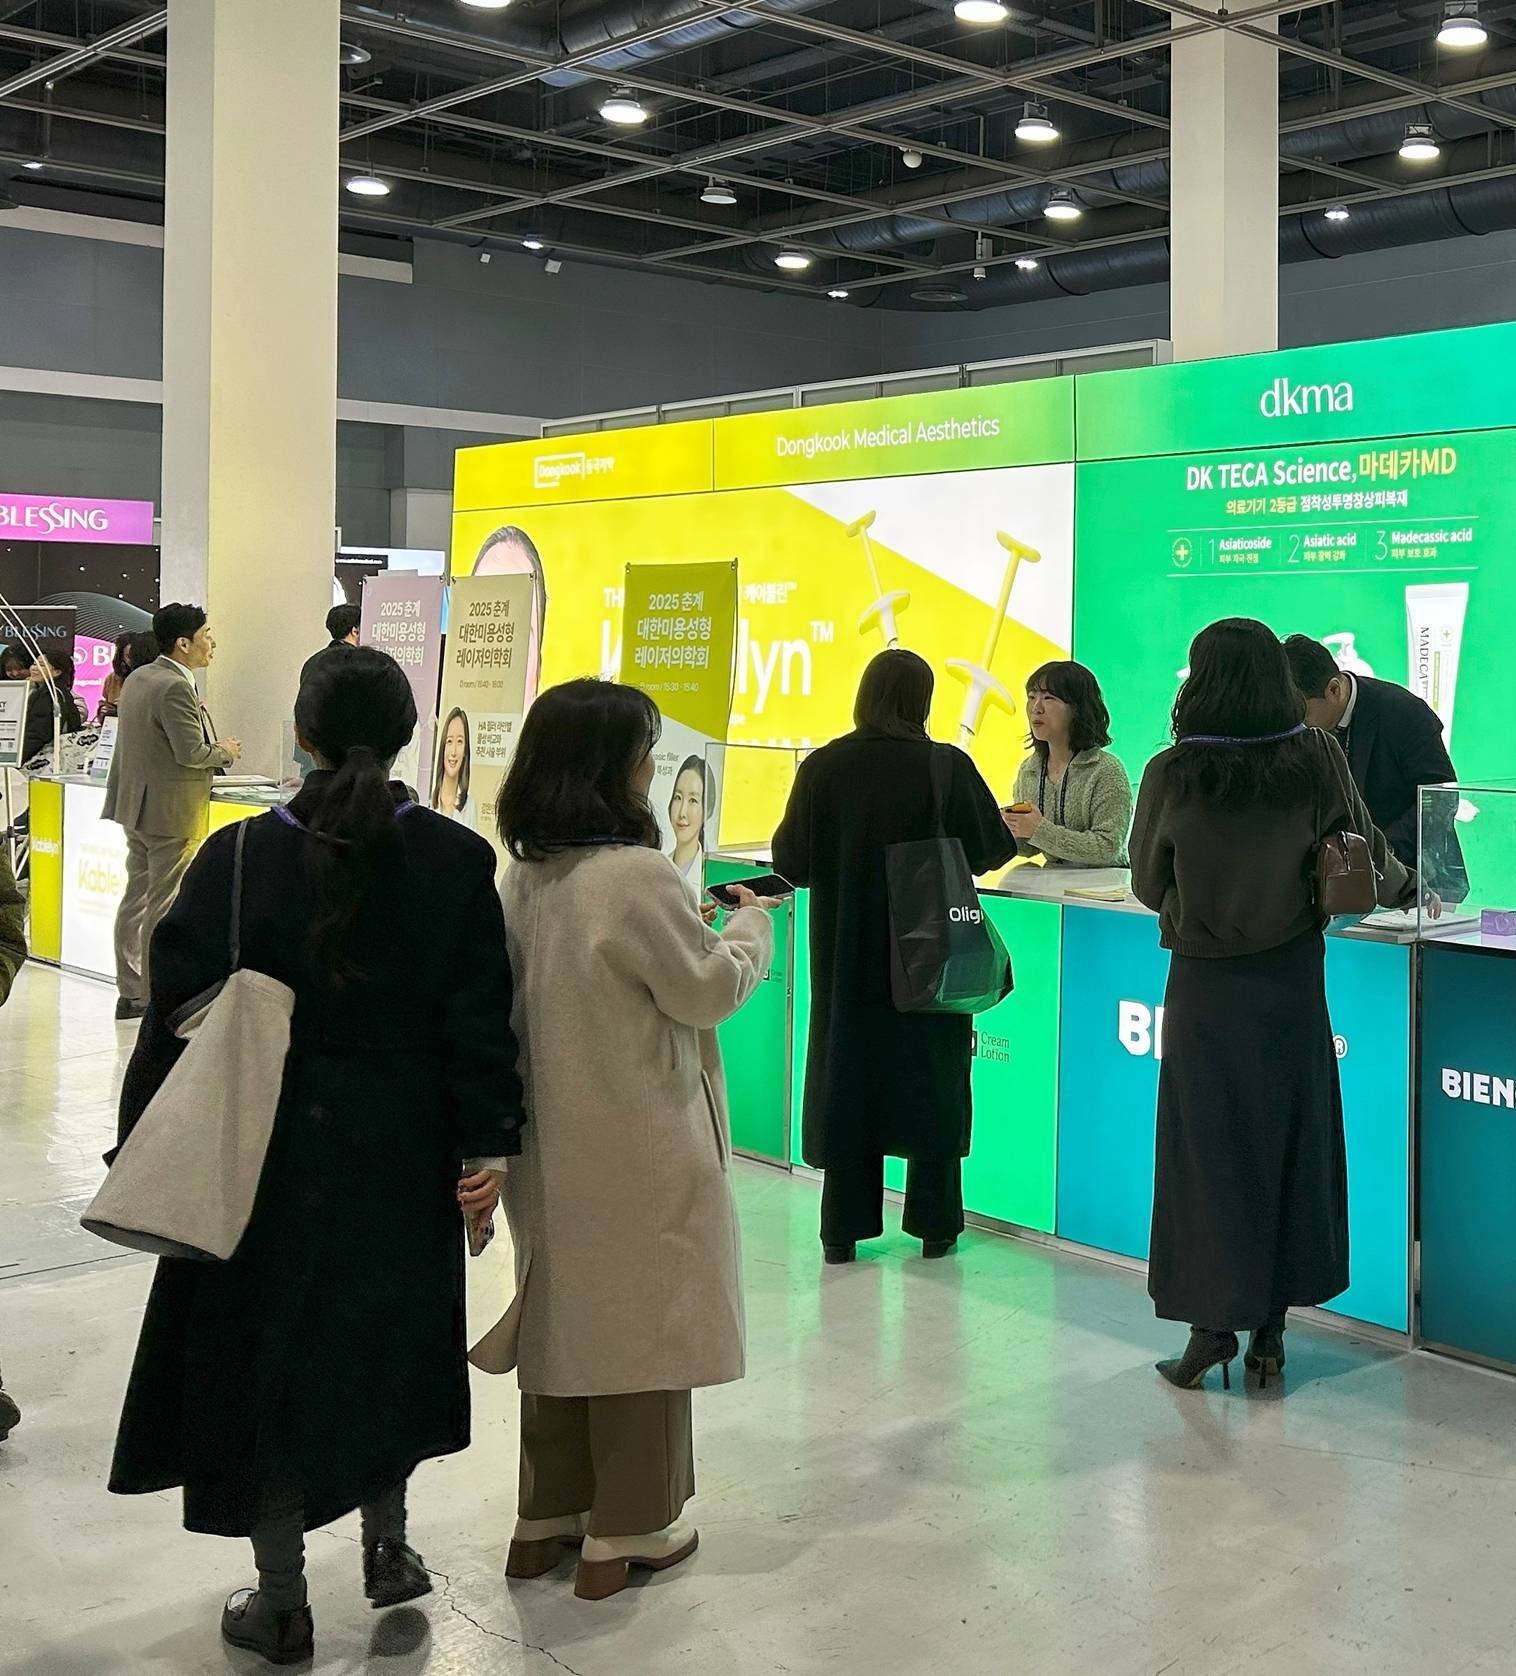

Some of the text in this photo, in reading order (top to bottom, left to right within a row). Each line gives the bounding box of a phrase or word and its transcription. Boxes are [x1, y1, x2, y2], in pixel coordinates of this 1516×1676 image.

[1260, 377, 1354, 417] dkma
[777, 414, 1000, 459] Dongkook Medical Aesthetics
[1187, 447, 1457, 490] DK TECA Science, 마데카MD
[1226, 497, 1266, 515] 의료기기
[1270, 496, 1297, 513] 2등급
[1208, 536, 1272, 565] 1 Asiaticoside
[1288, 532, 1357, 563] 2 Asiatic acid
[1375, 528, 1473, 560] 3 Madecassic acid
[380, 600, 421, 617] 2025 춘계
[469, 600, 510, 617] 2025 춘계
[649, 591, 704, 611] 2025 춘계
[371, 621, 426, 642] 대한미용성형
[458, 623, 515, 643] 대한미용성형
[636, 617, 712, 641] 대한미용성형
[373, 648, 425, 667] 저의학회
[456, 647, 513, 669] 레이저의학회
[634, 645, 710, 669] 레이저의학회
[1418, 626, 1430, 680] MADECA
[981, 1031, 1010, 1049] Cream
[981, 1049, 1010, 1063] Lotion
